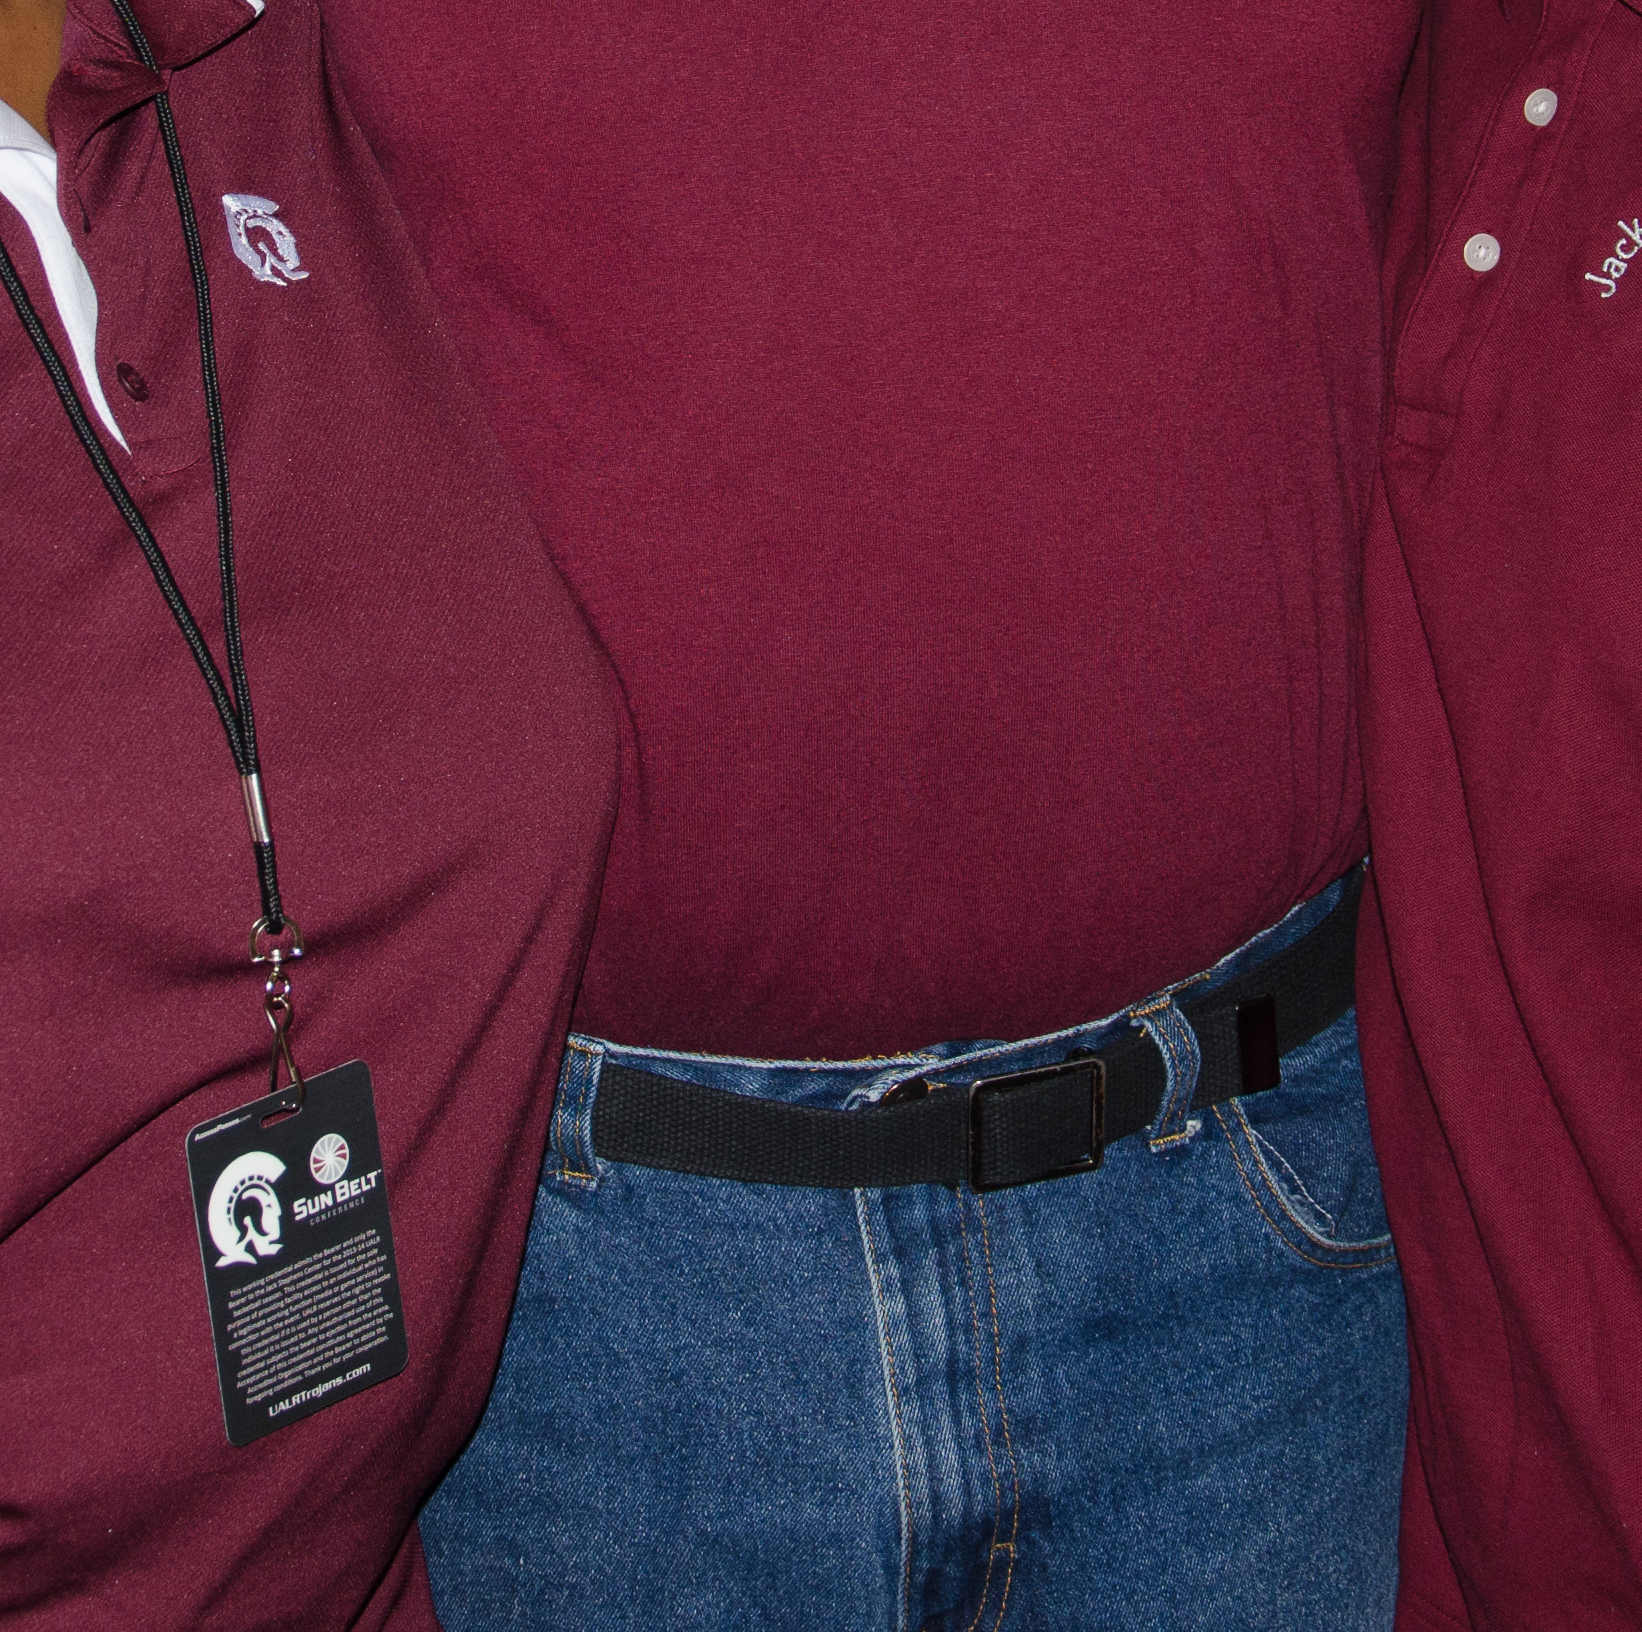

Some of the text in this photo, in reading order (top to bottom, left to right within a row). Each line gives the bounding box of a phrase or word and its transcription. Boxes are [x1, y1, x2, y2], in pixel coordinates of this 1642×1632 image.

[292, 1170, 378, 1222] SUN BELT
[309, 1195, 366, 1226] CONFERENCE
[267, 1363, 372, 1418] UALRTrojans.com
